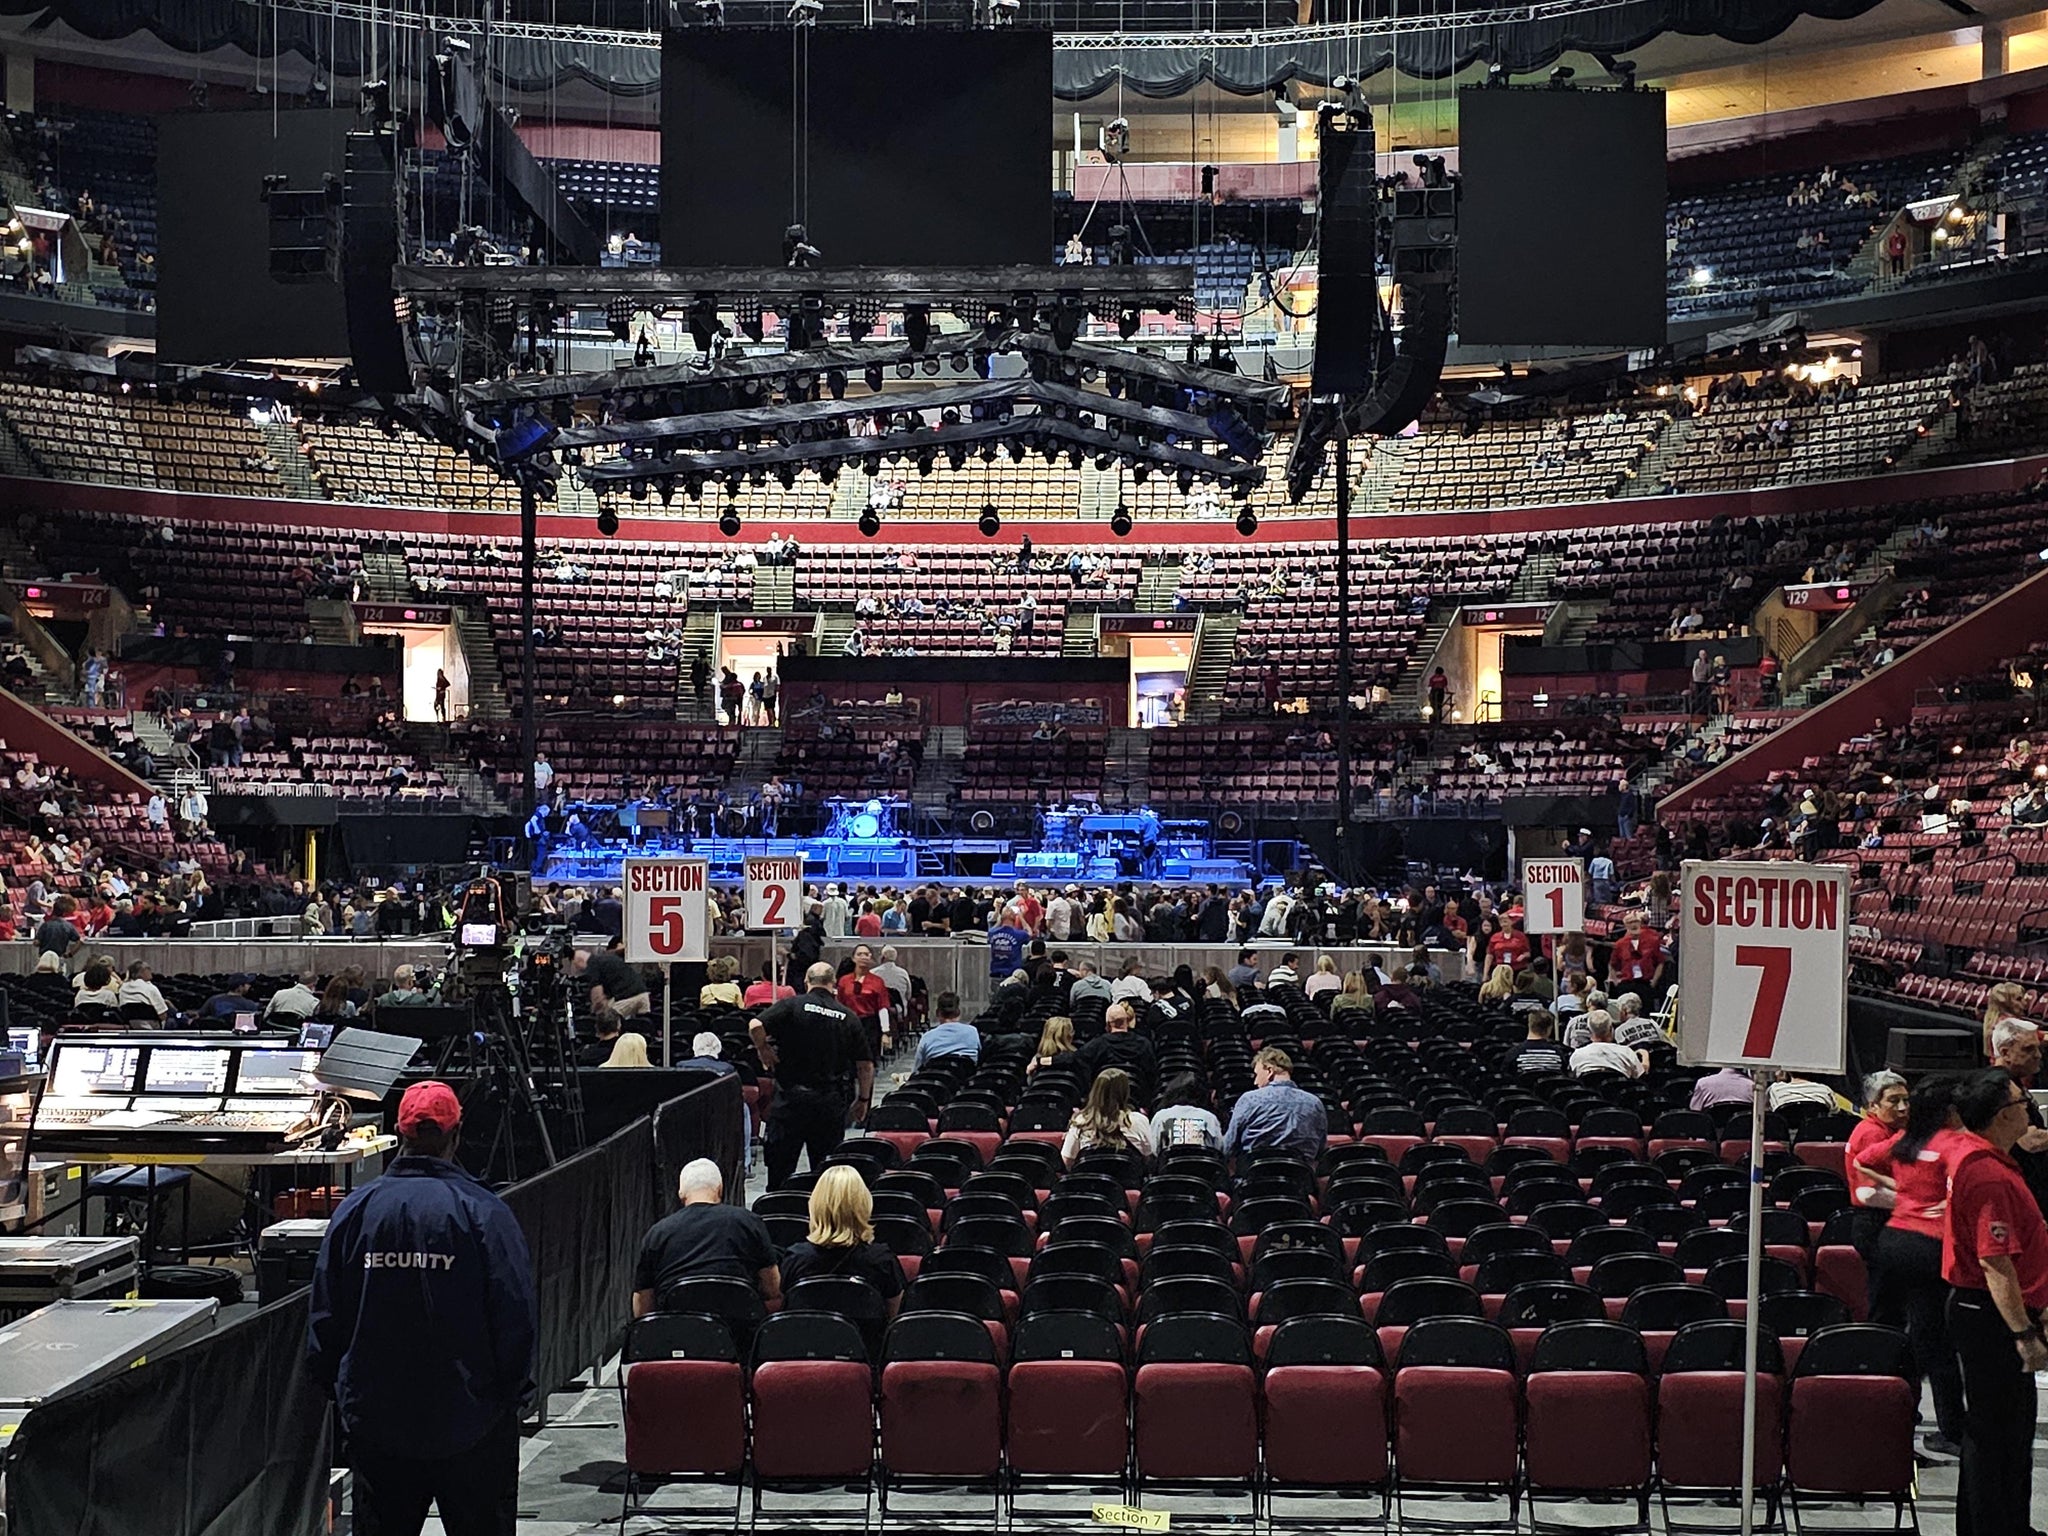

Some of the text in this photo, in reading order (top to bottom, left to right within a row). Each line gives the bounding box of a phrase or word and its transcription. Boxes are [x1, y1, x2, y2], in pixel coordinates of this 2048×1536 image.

[82, 591, 103, 604] 124
[1788, 591, 1809, 605] 129
[364, 608, 384, 620] 124
[423, 610, 443, 622] 125
[1105, 619, 1125, 631] 127
[1174, 619, 1194, 631] 128
[1466, 611, 1485, 623] 128
[724, 620, 742, 631] 125
[780, 620, 800, 631] 127
[631, 865, 703, 892] SECTION
[750, 861, 799, 882] SECTION
[1527, 864, 1580, 884] SECTION
[762, 884, 786, 925] 2
[1545, 887, 1563, 928] 1
[1693, 874, 1838, 931] SECTION
[648, 896, 684, 955] 5
[804, 1003, 847, 1021] SECURITY
[1735, 945, 1792, 1059] 7
[363, 1251, 456, 1271] SECURITY
[1097, 1507, 1162, 1526] Section 7
